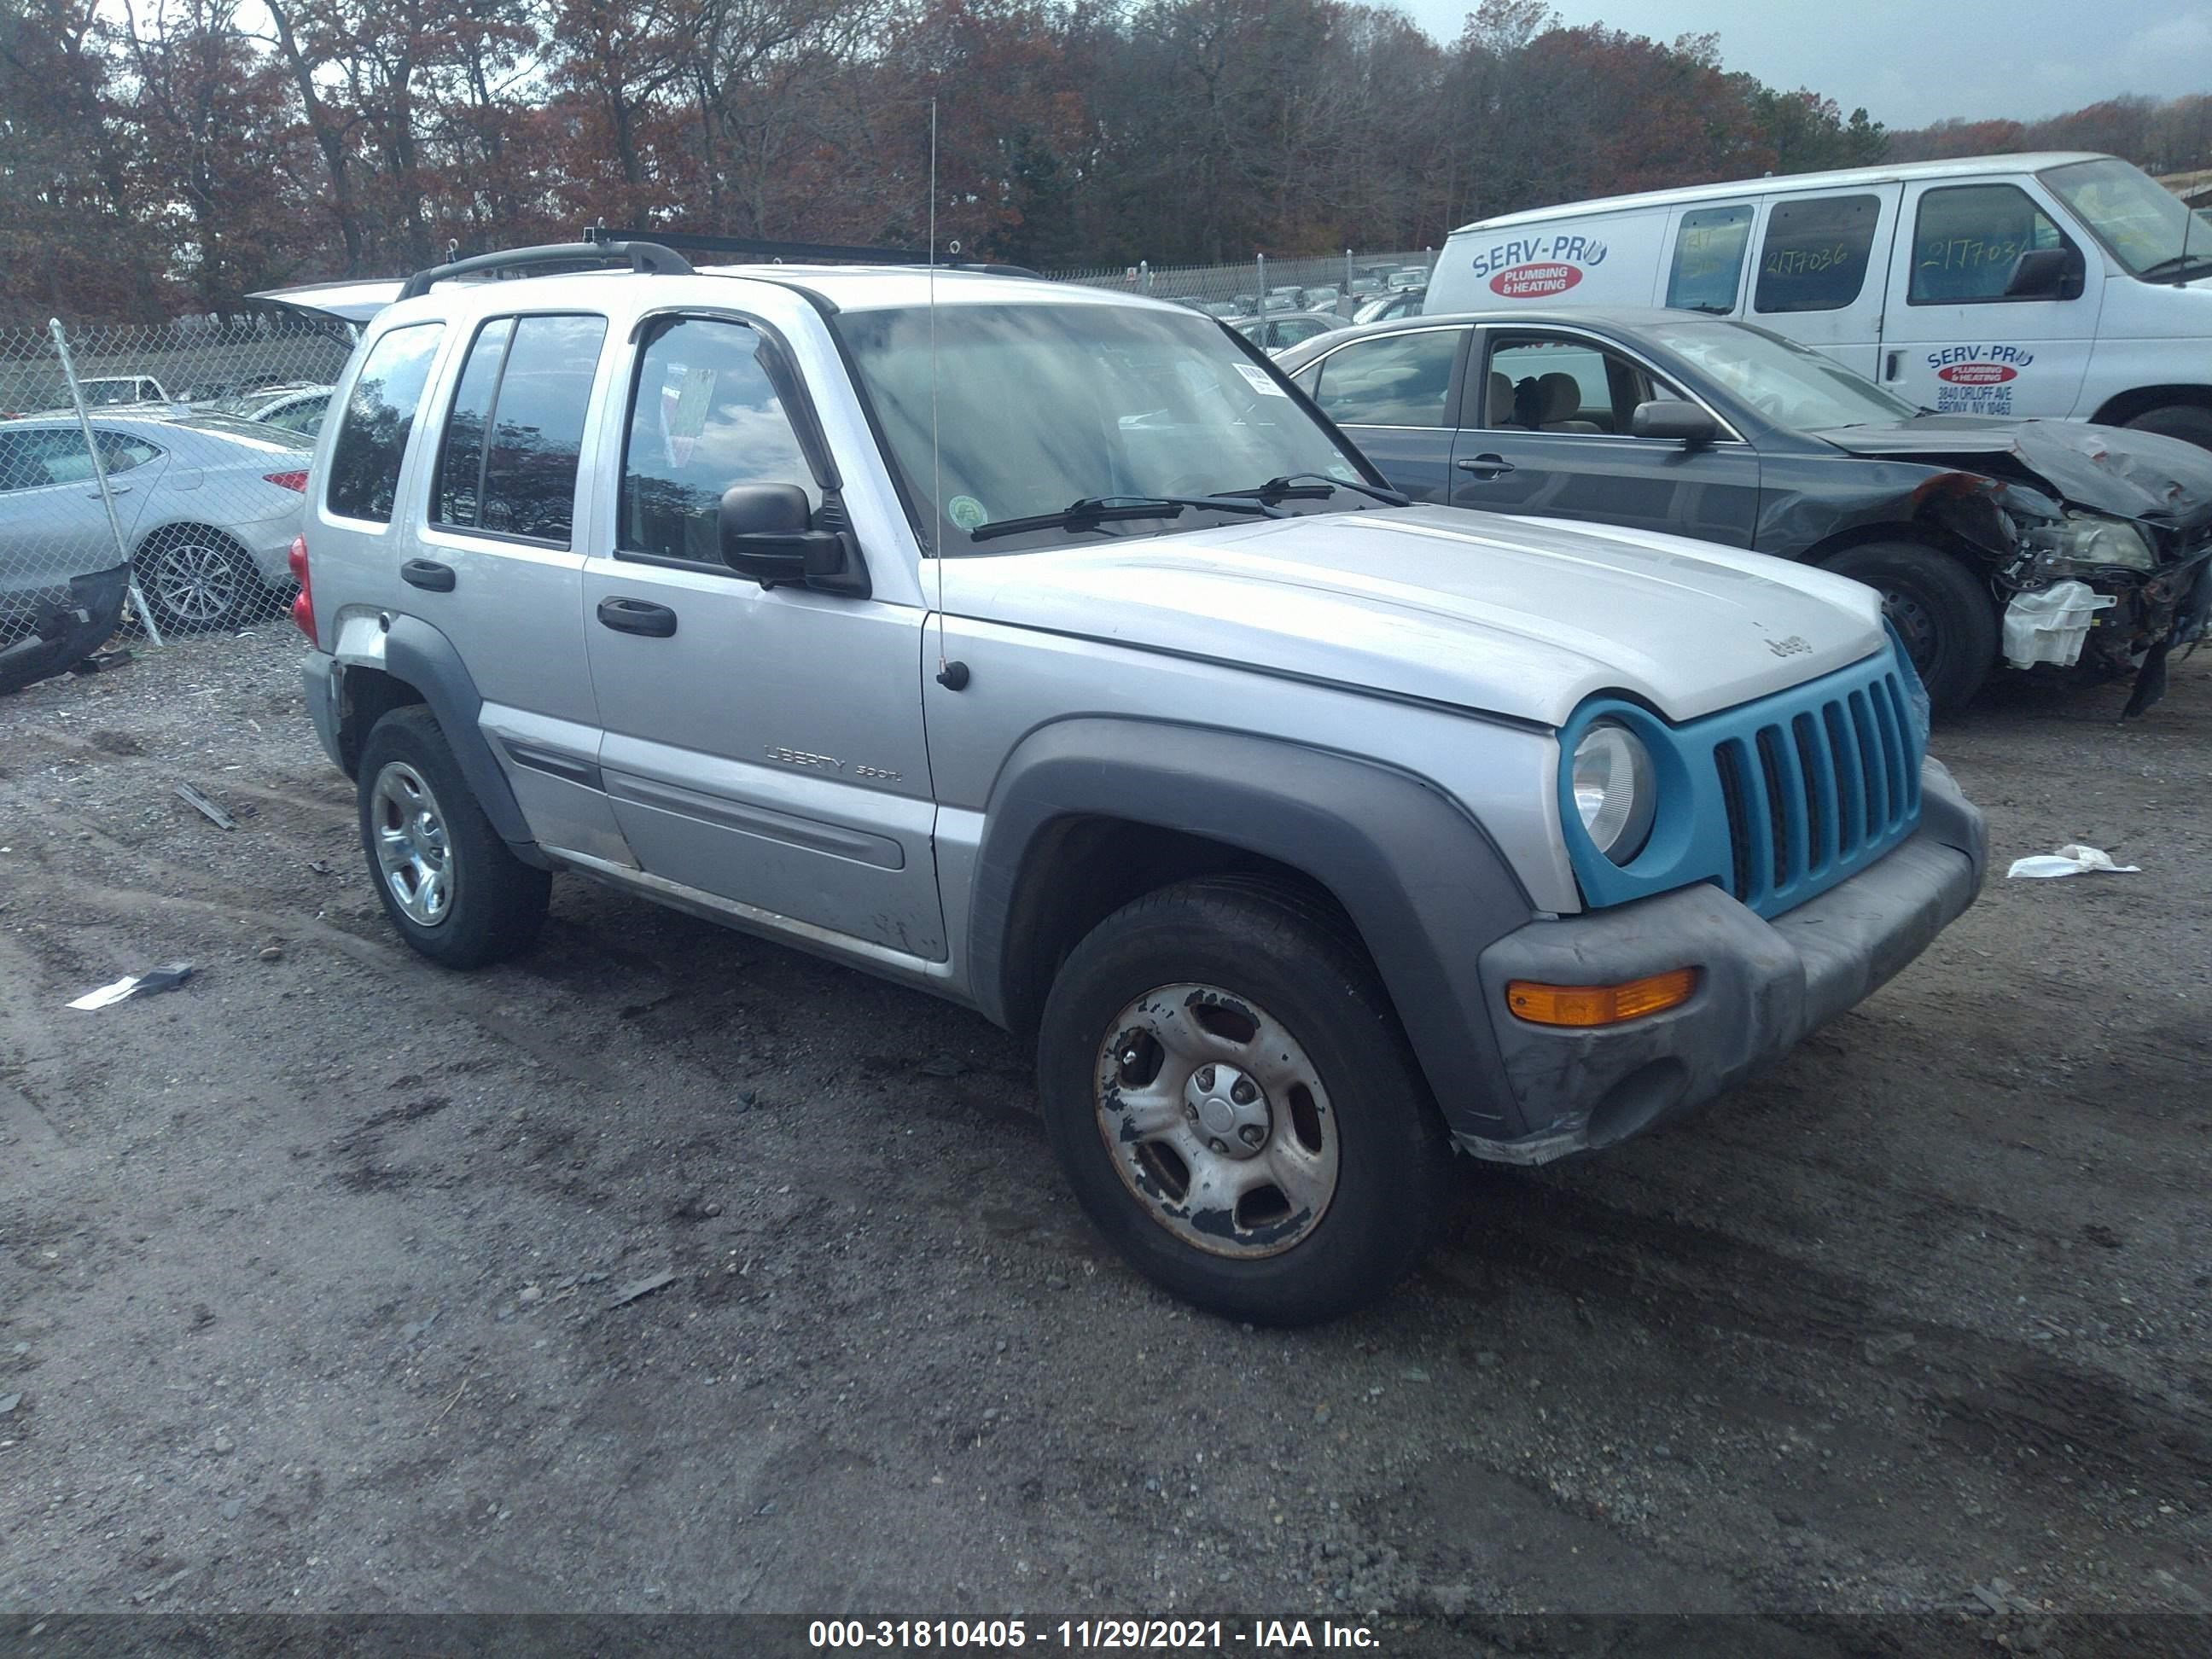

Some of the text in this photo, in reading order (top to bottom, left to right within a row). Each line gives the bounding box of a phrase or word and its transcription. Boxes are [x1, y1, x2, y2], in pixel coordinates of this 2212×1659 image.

[1505, 266, 1569, 282] PLUMBING
[1503, 279, 1566, 294] & HEATING
[763, 744, 847, 773] LIBERTY
